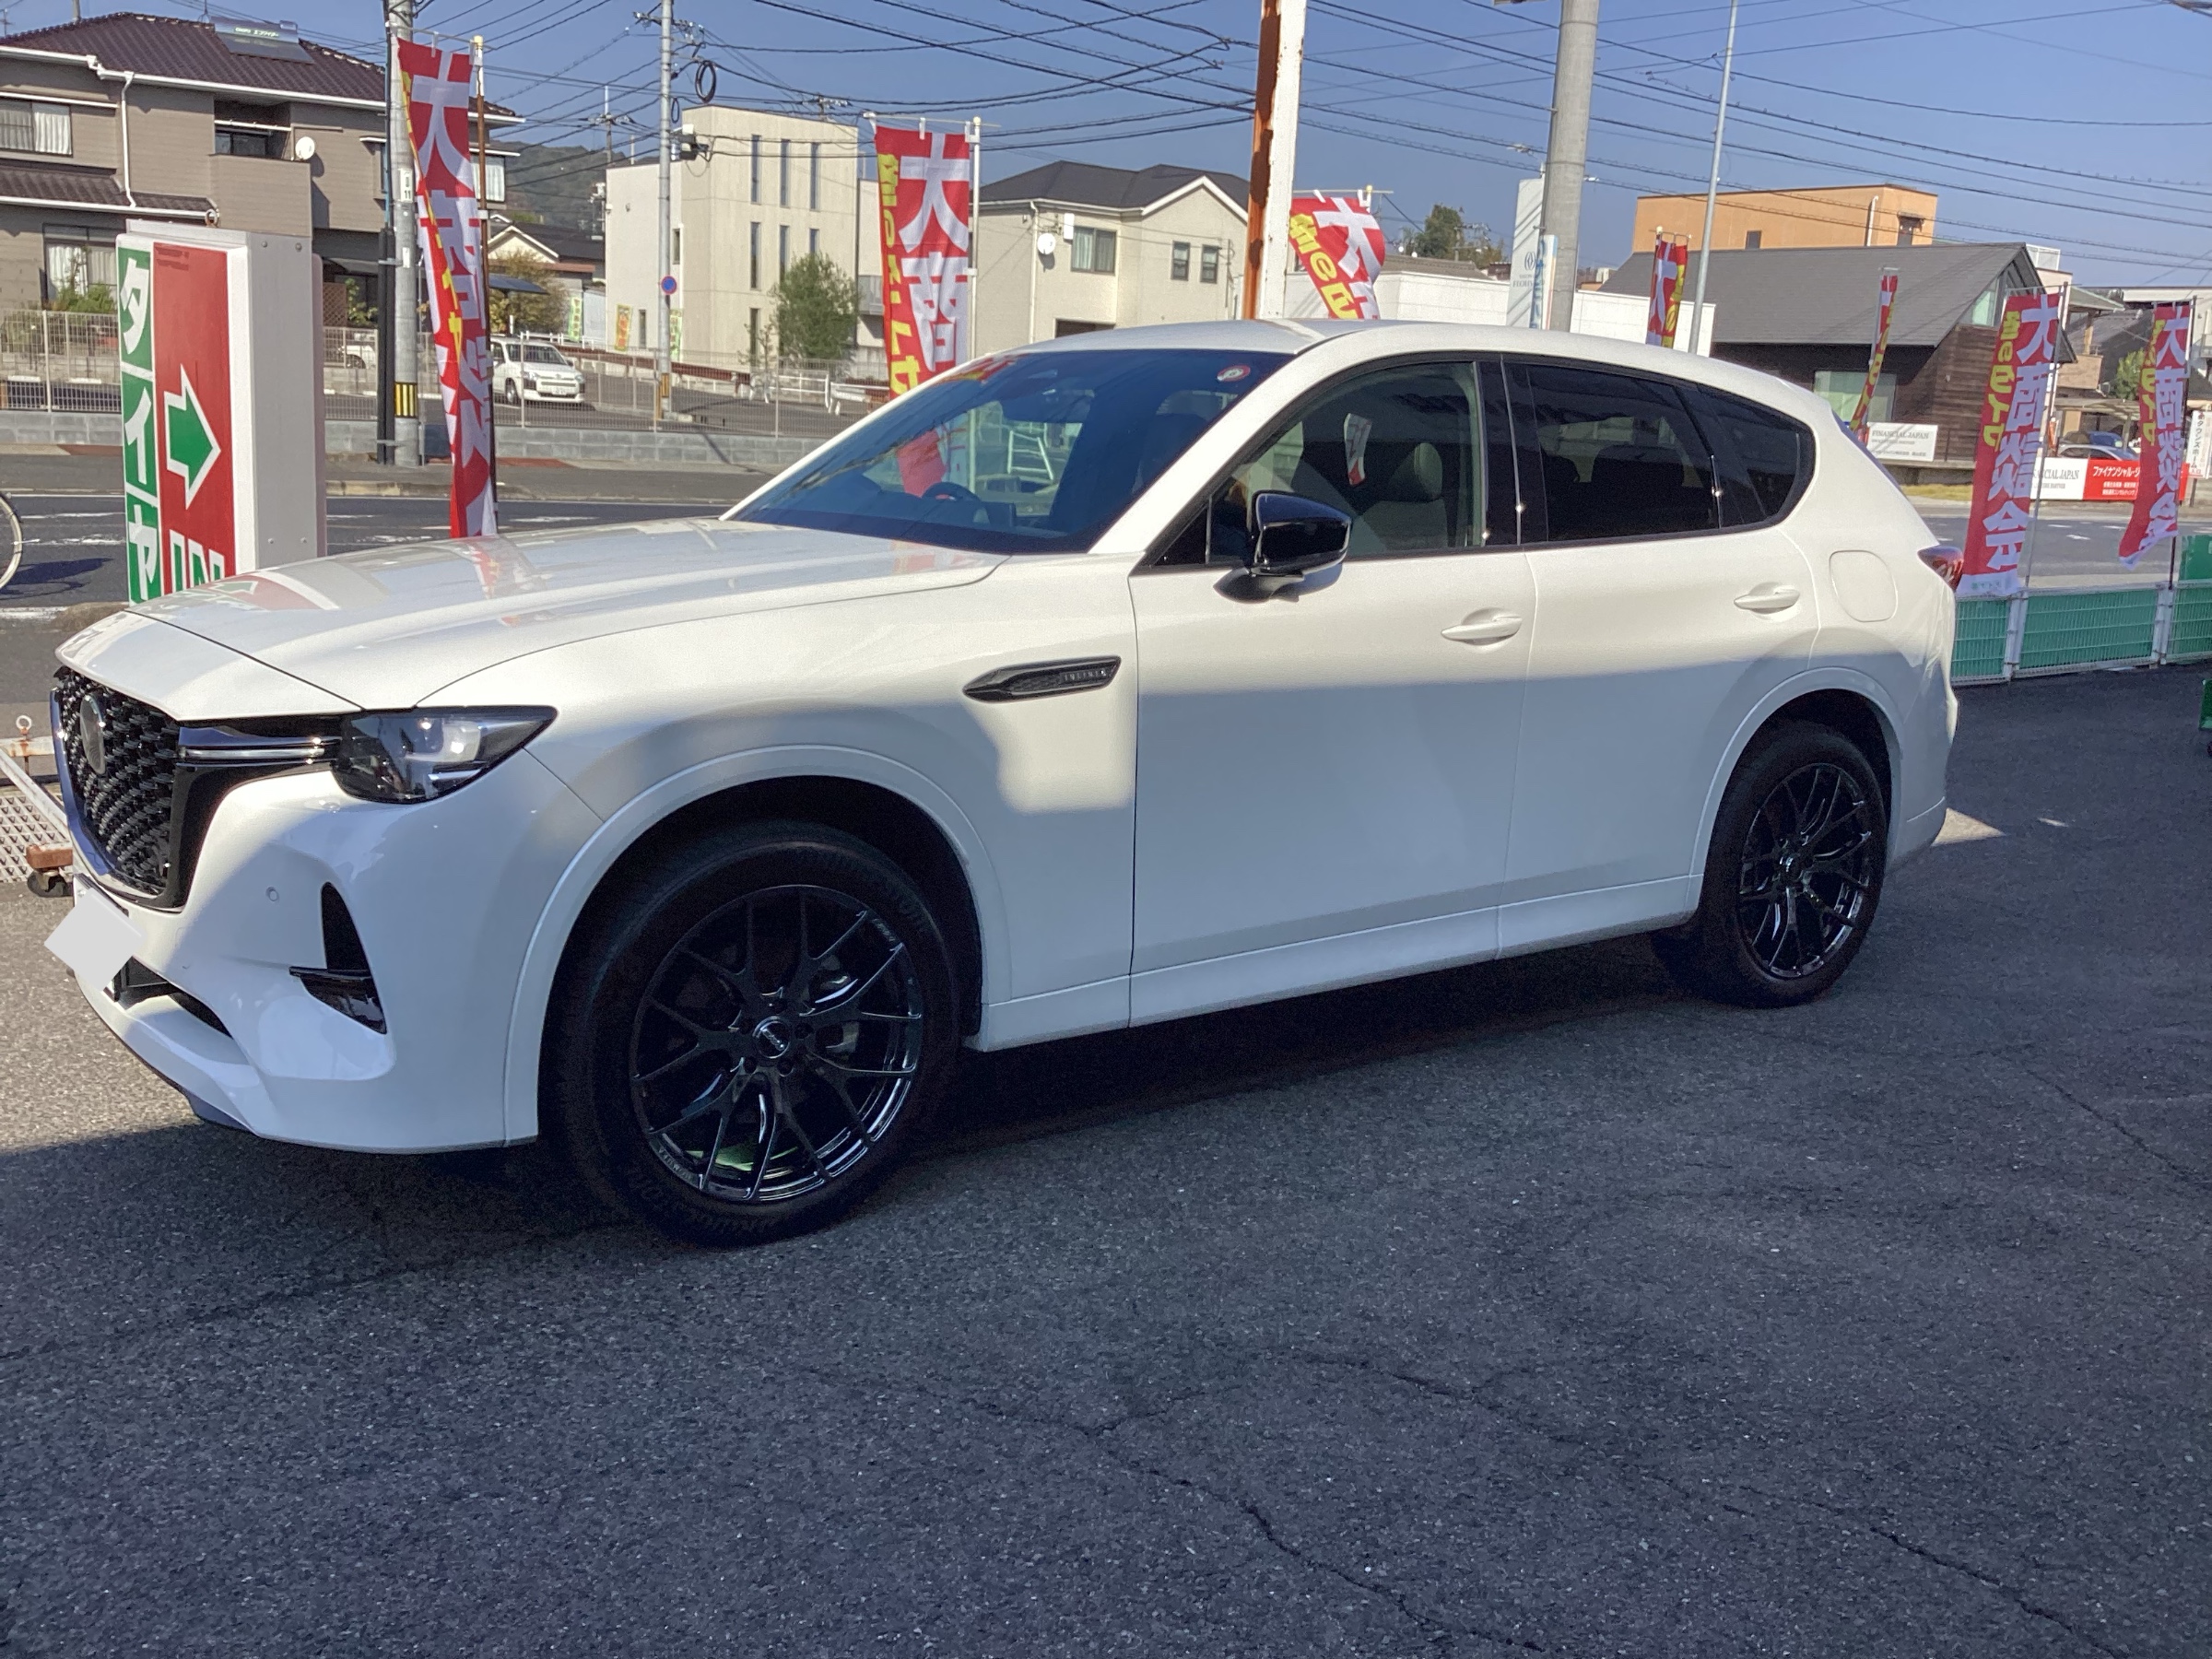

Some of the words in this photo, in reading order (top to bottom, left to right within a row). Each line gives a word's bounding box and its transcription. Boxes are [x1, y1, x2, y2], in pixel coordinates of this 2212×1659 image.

[119, 256, 158, 601] タイヤ
[2060, 469, 2079, 480] JAPAN
